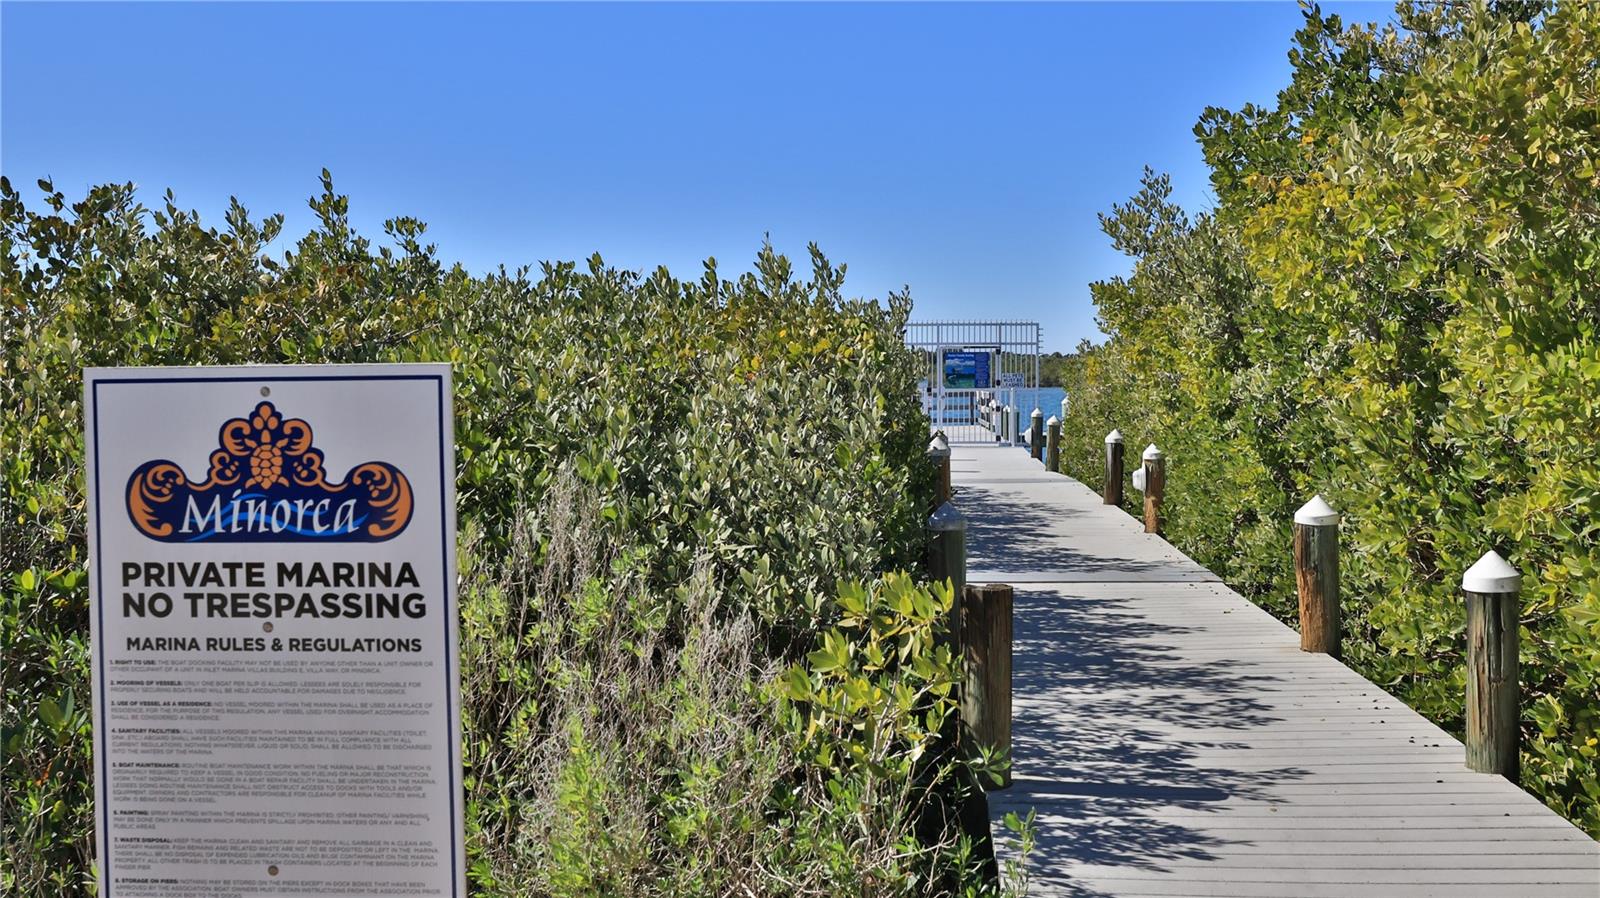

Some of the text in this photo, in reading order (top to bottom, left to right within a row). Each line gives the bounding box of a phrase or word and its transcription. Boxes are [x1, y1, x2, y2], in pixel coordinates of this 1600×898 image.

[178, 489, 360, 533] Minorca
[122, 562, 420, 587] PRIVATE MARINA
[122, 593, 427, 619] NO TRESPASSING
[126, 637, 423, 653] MARINA RULES & REGULATIONS
